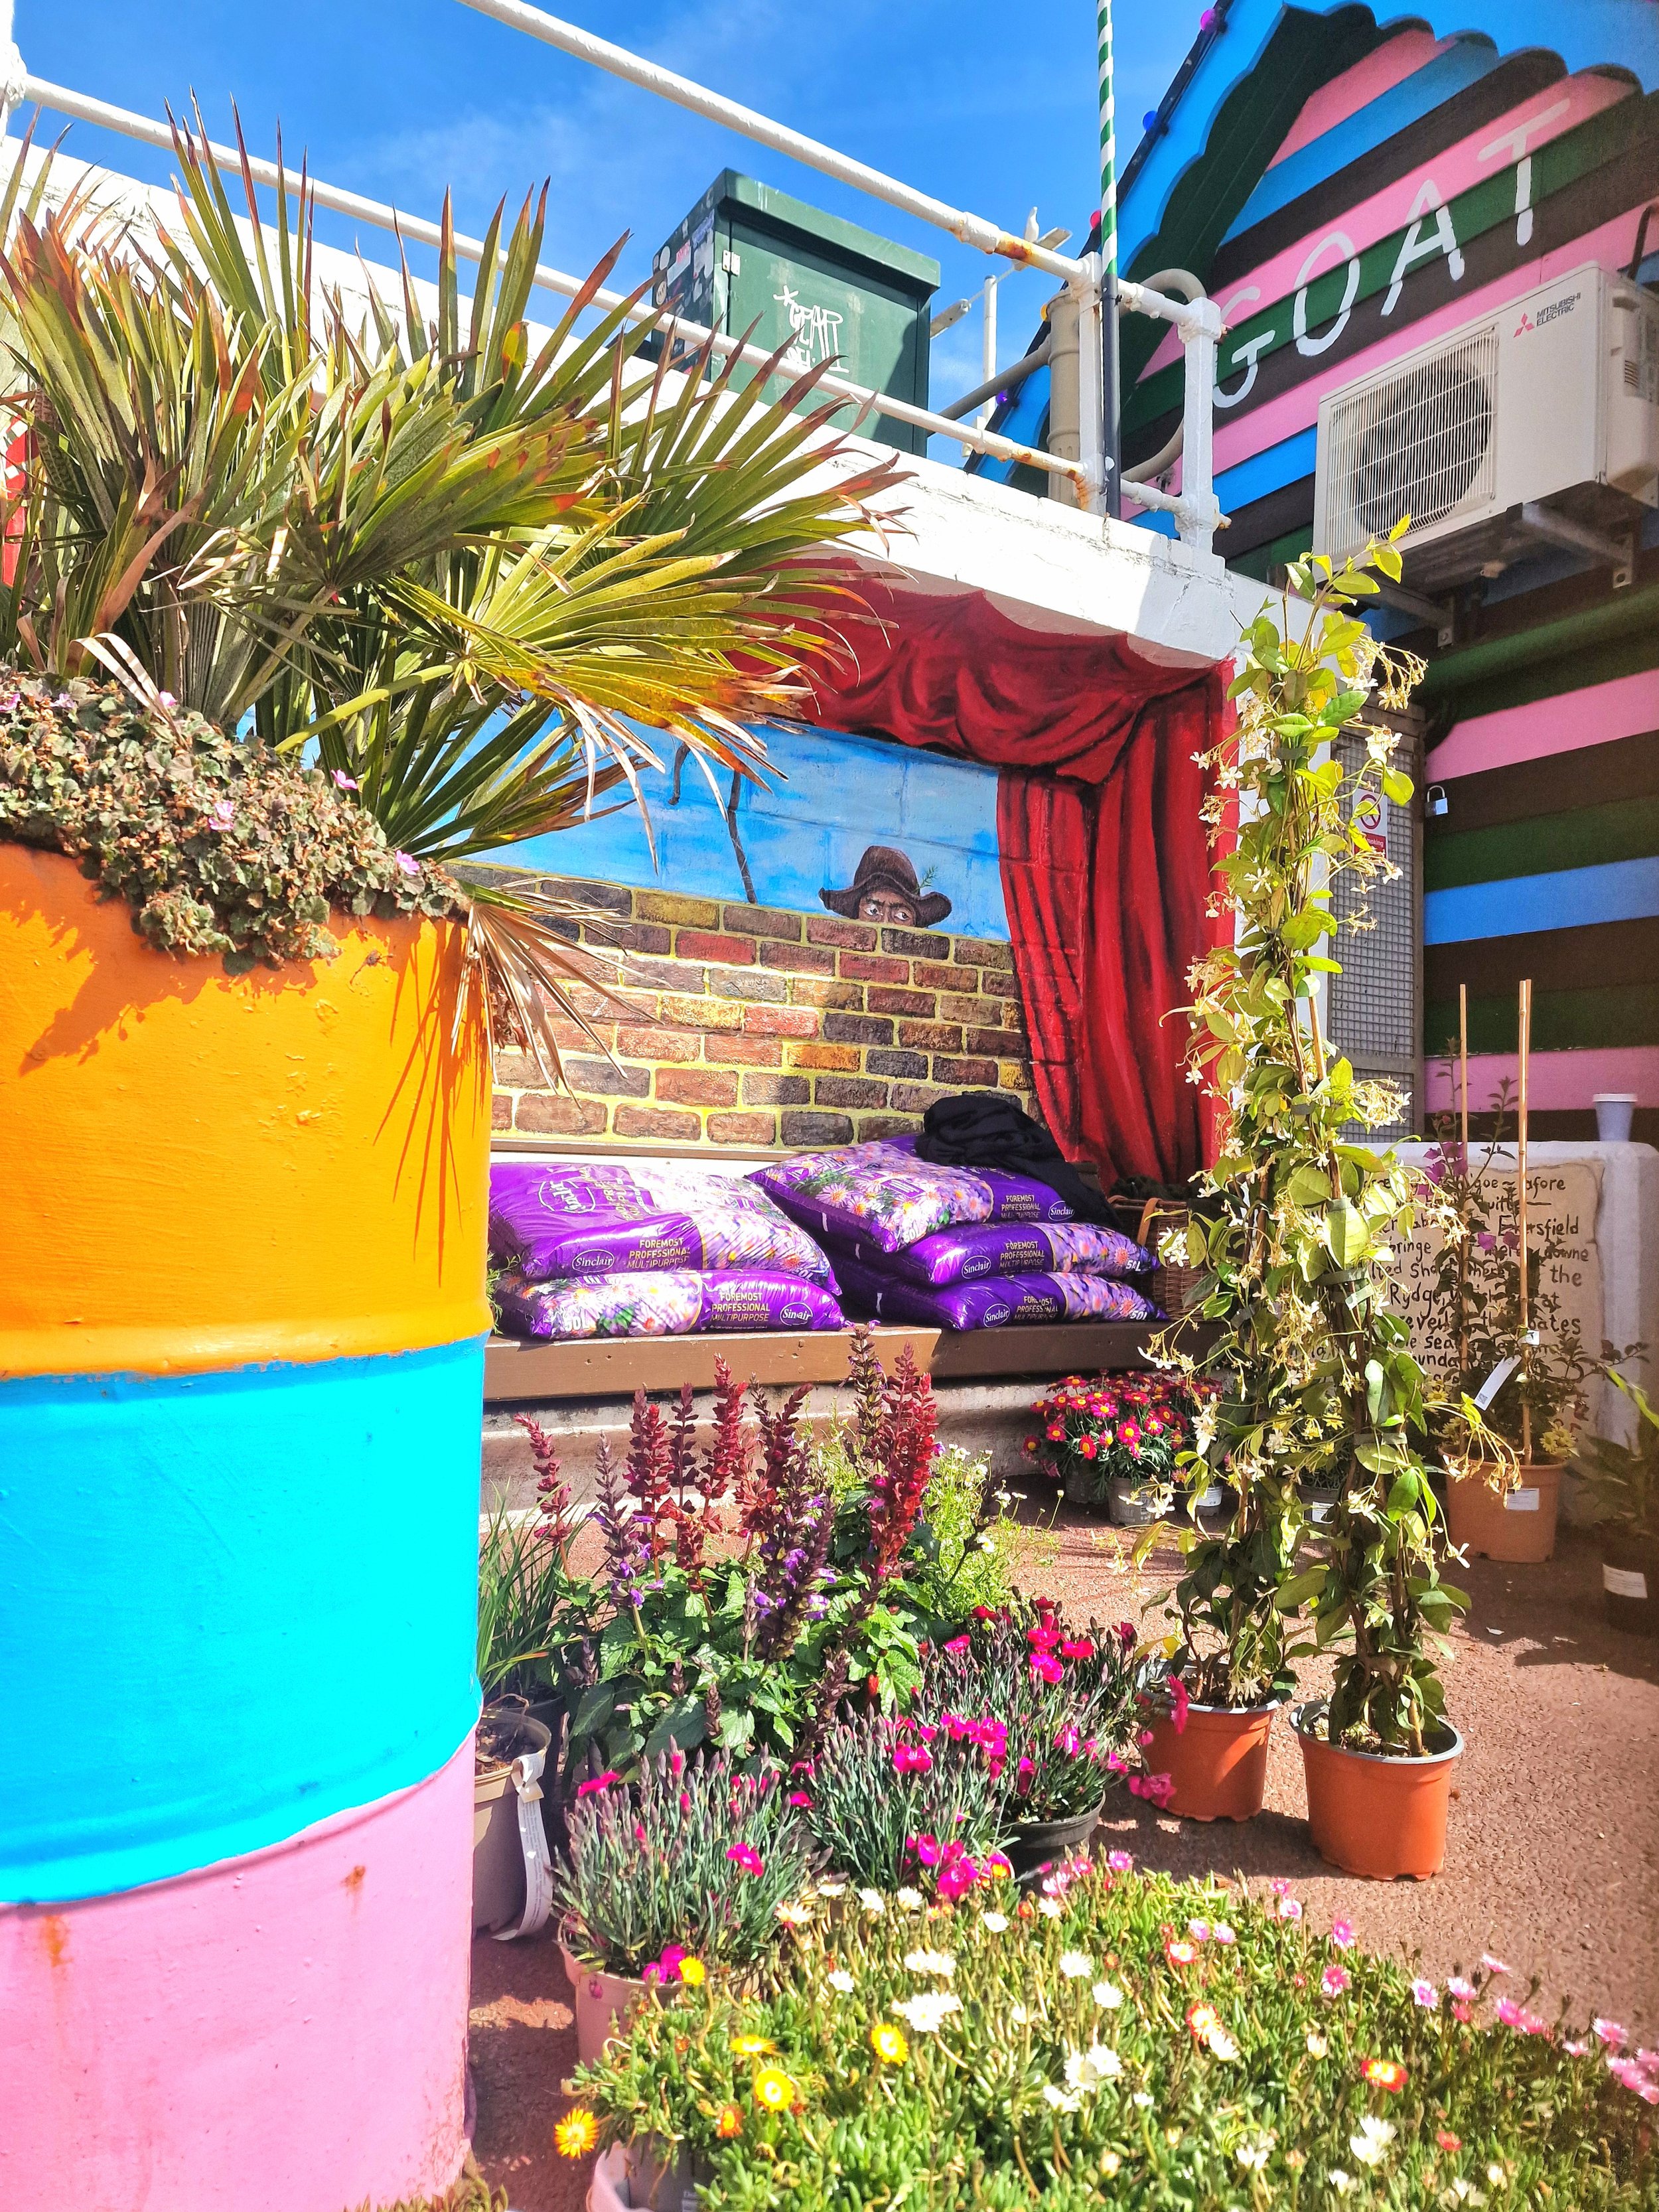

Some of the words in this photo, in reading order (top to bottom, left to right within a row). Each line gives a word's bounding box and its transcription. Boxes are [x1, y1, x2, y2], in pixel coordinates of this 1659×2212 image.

[1212, 98, 1570, 408] GOAT
[1536, 292, 1581, 319] MITSUBISHI
[1536, 303, 1575, 327] ELECTRIC
[1050, 1207, 1074, 1216] Sinclair
[639, 1237, 684, 1249] FOREMOST
[1005, 1241, 1039, 1250] FOREMOST
[1000, 1250, 1045, 1261] PROFESSIONAL
[575, 1256, 614, 1268] Sinclair
[963, 1261, 990, 1275] Sinclair
[1550, 1264, 1582, 1287] the
[720, 1292, 763, 1301] FOREMOST
[1023, 1295, 1054, 1306] FOROST
[711, 1302, 770, 1313] PROFESSIONAL
[1016, 1305, 1058, 1314] PROFESSNAL
[710, 1313, 770, 1322] MULTIPURPOSE
[782, 1308, 812, 1321] Sinair
[985, 1309, 1009, 1323] Sinclair
